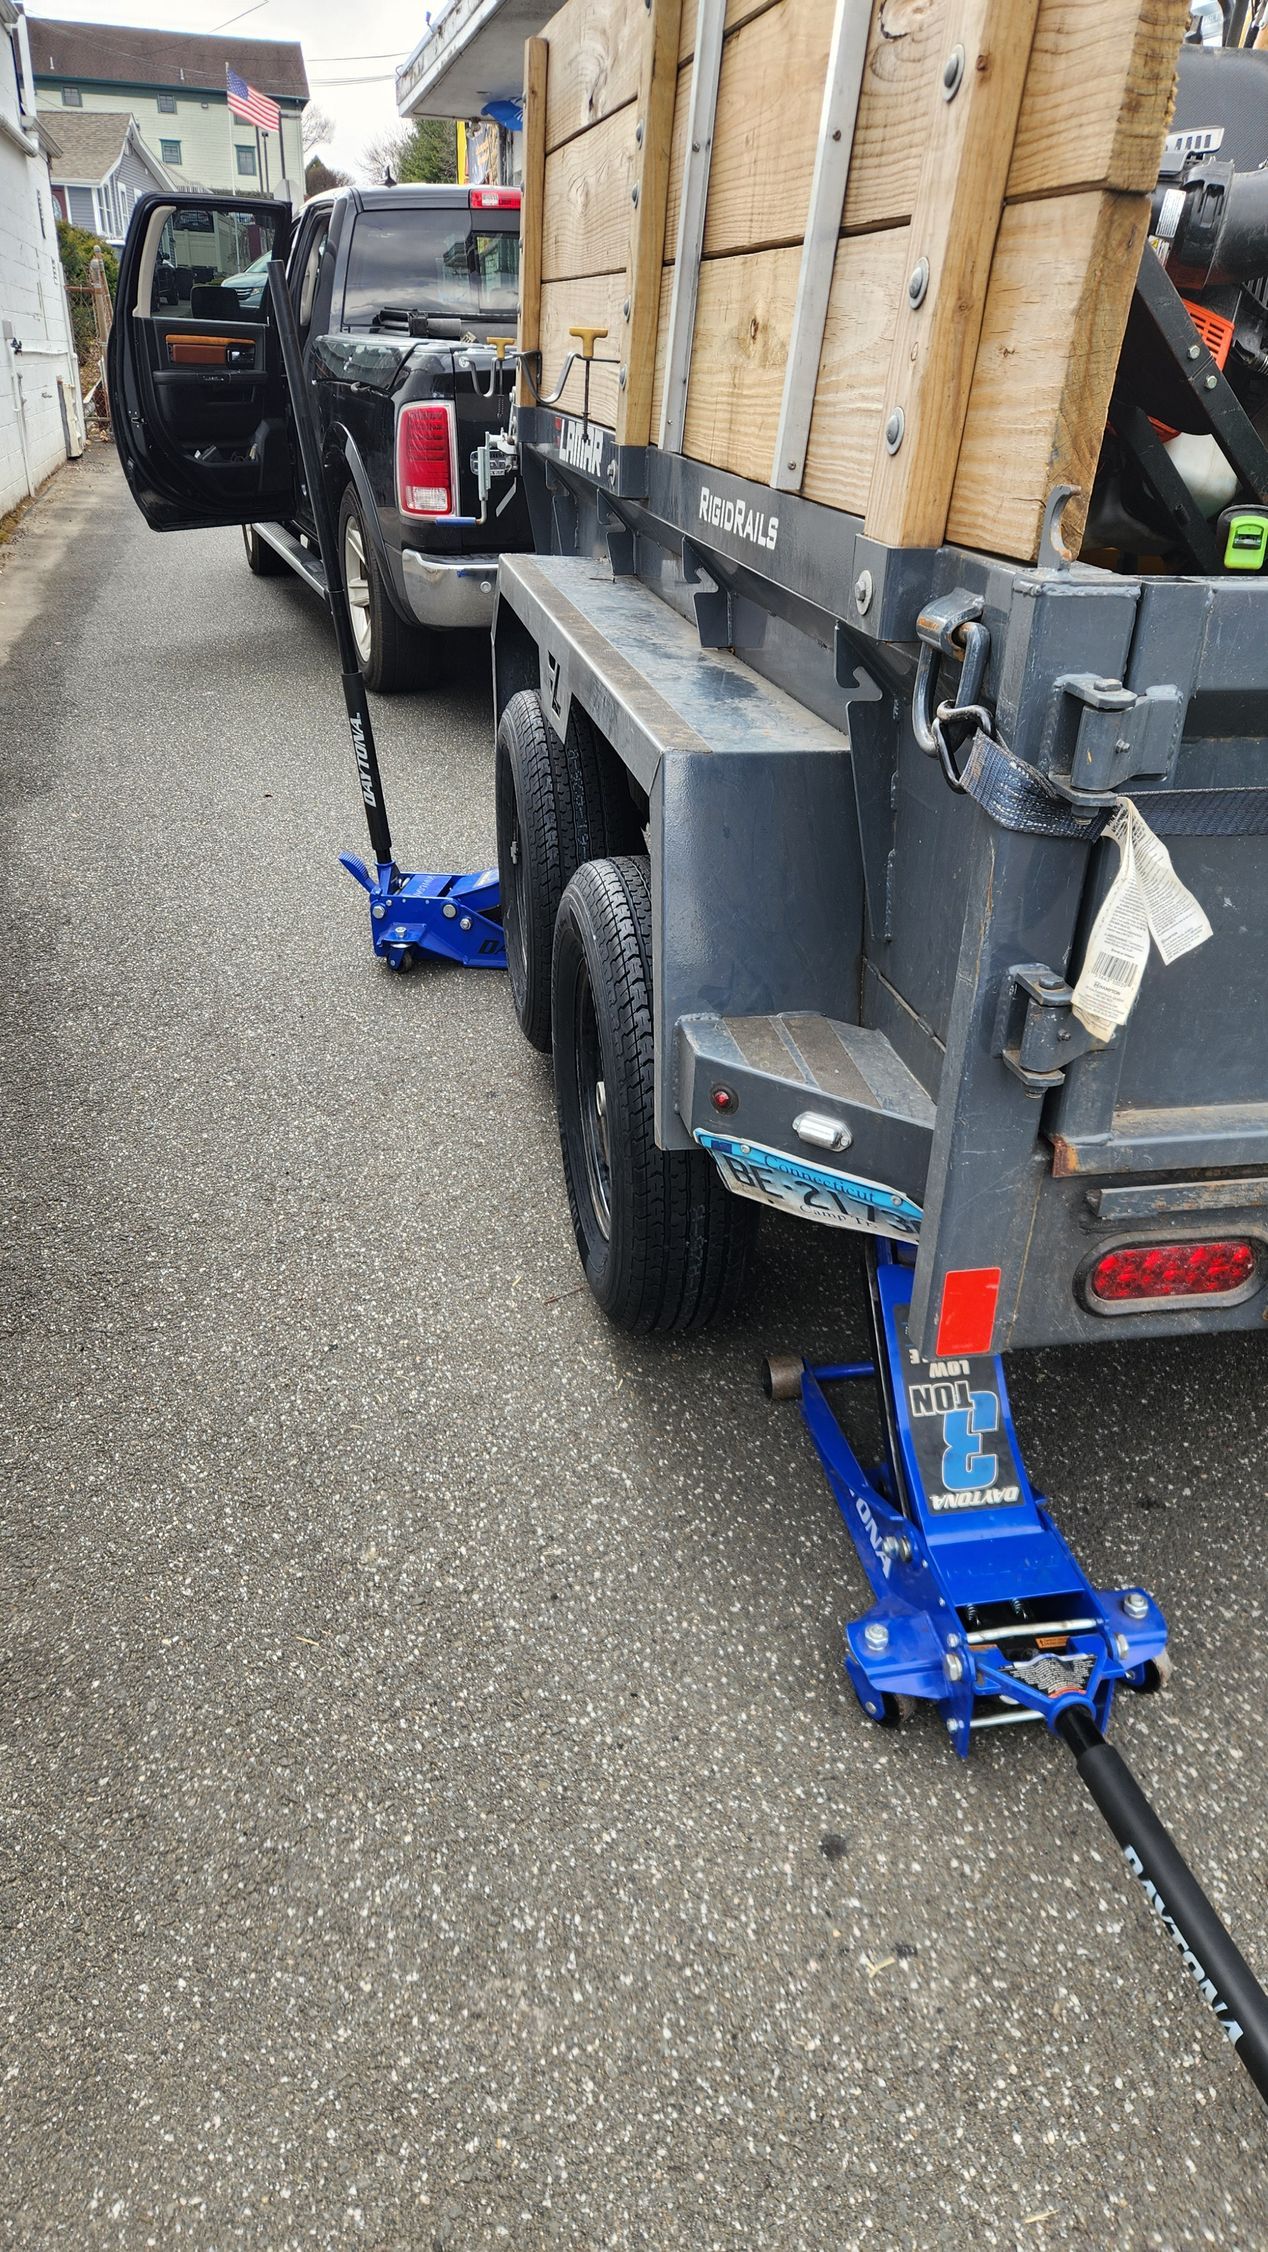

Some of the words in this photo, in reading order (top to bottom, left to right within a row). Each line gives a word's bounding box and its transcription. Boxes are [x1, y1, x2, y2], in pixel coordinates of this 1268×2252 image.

[349, 717, 377, 808] DAYTONA
[764, 1155, 876, 1202] Connecticut
[799, 1204, 847, 1222] Camp
[929, 1359, 971, 1379] LOW
[908, 1379, 976, 1418] TON
[942, 1390, 999, 1491] 3
[929, 1486, 1020, 1511] DAYTONA
